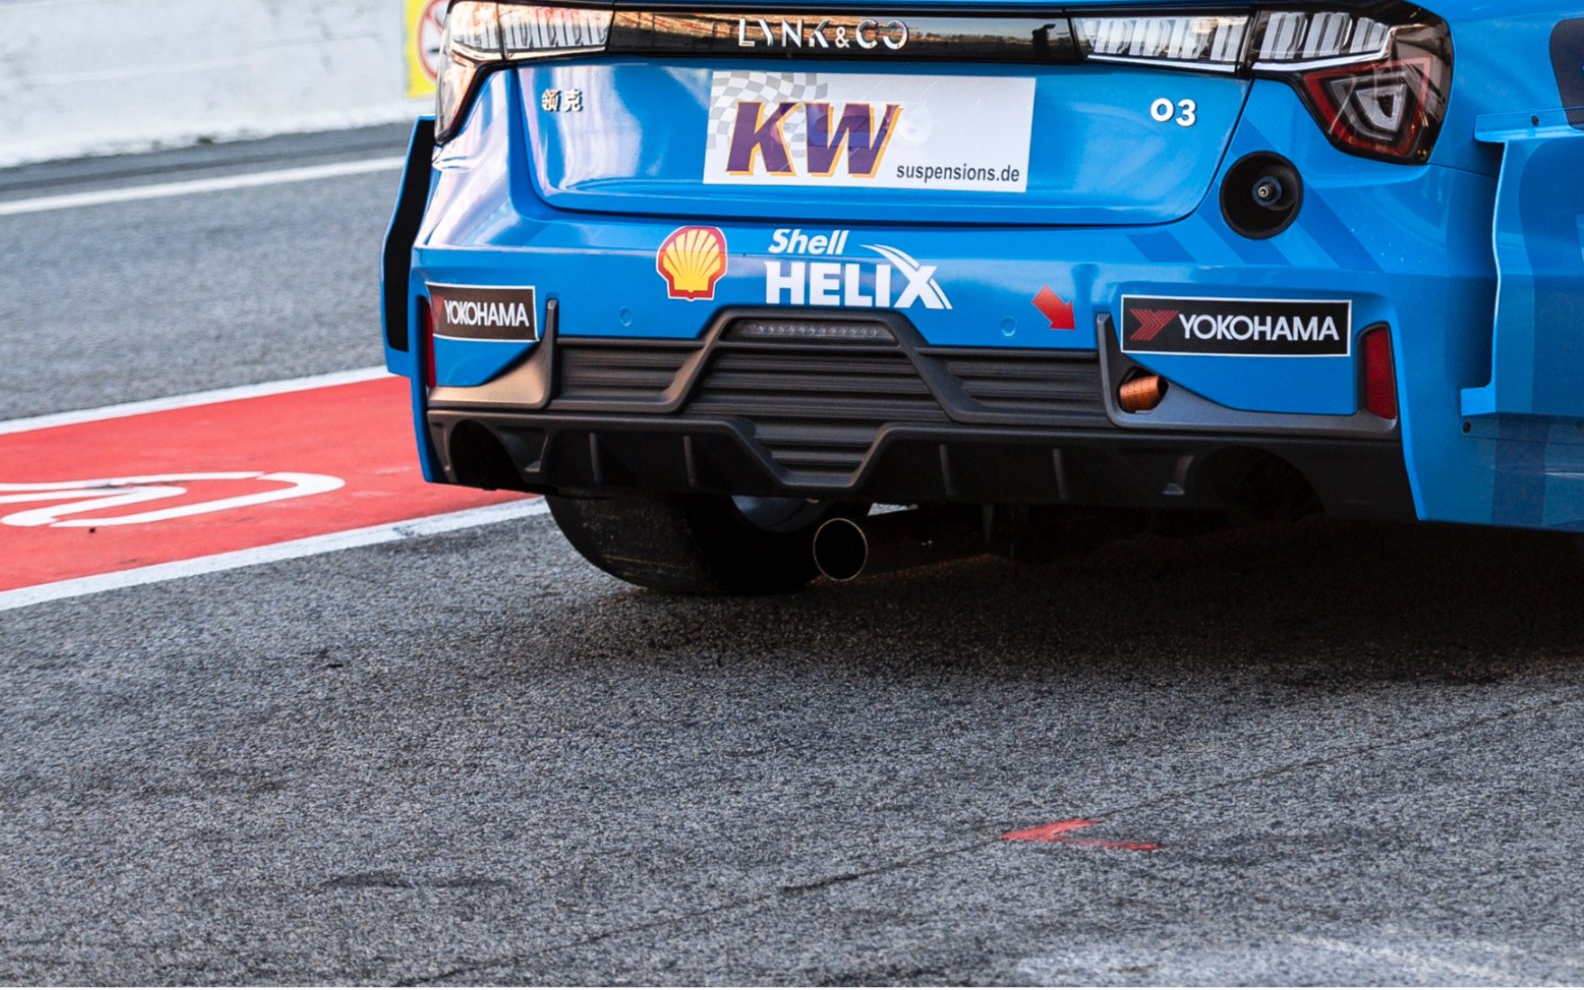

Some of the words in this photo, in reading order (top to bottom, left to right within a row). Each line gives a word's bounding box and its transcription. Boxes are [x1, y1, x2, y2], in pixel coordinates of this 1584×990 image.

[725, 101, 903, 178] KW
[896, 163, 1020, 184] suspensions.de
[768, 229, 850, 256] Shell
[764, 243, 953, 311] HELIX
[443, 298, 530, 328] YOKOHAMA
[1178, 313, 1340, 343] YOKOHAMA
